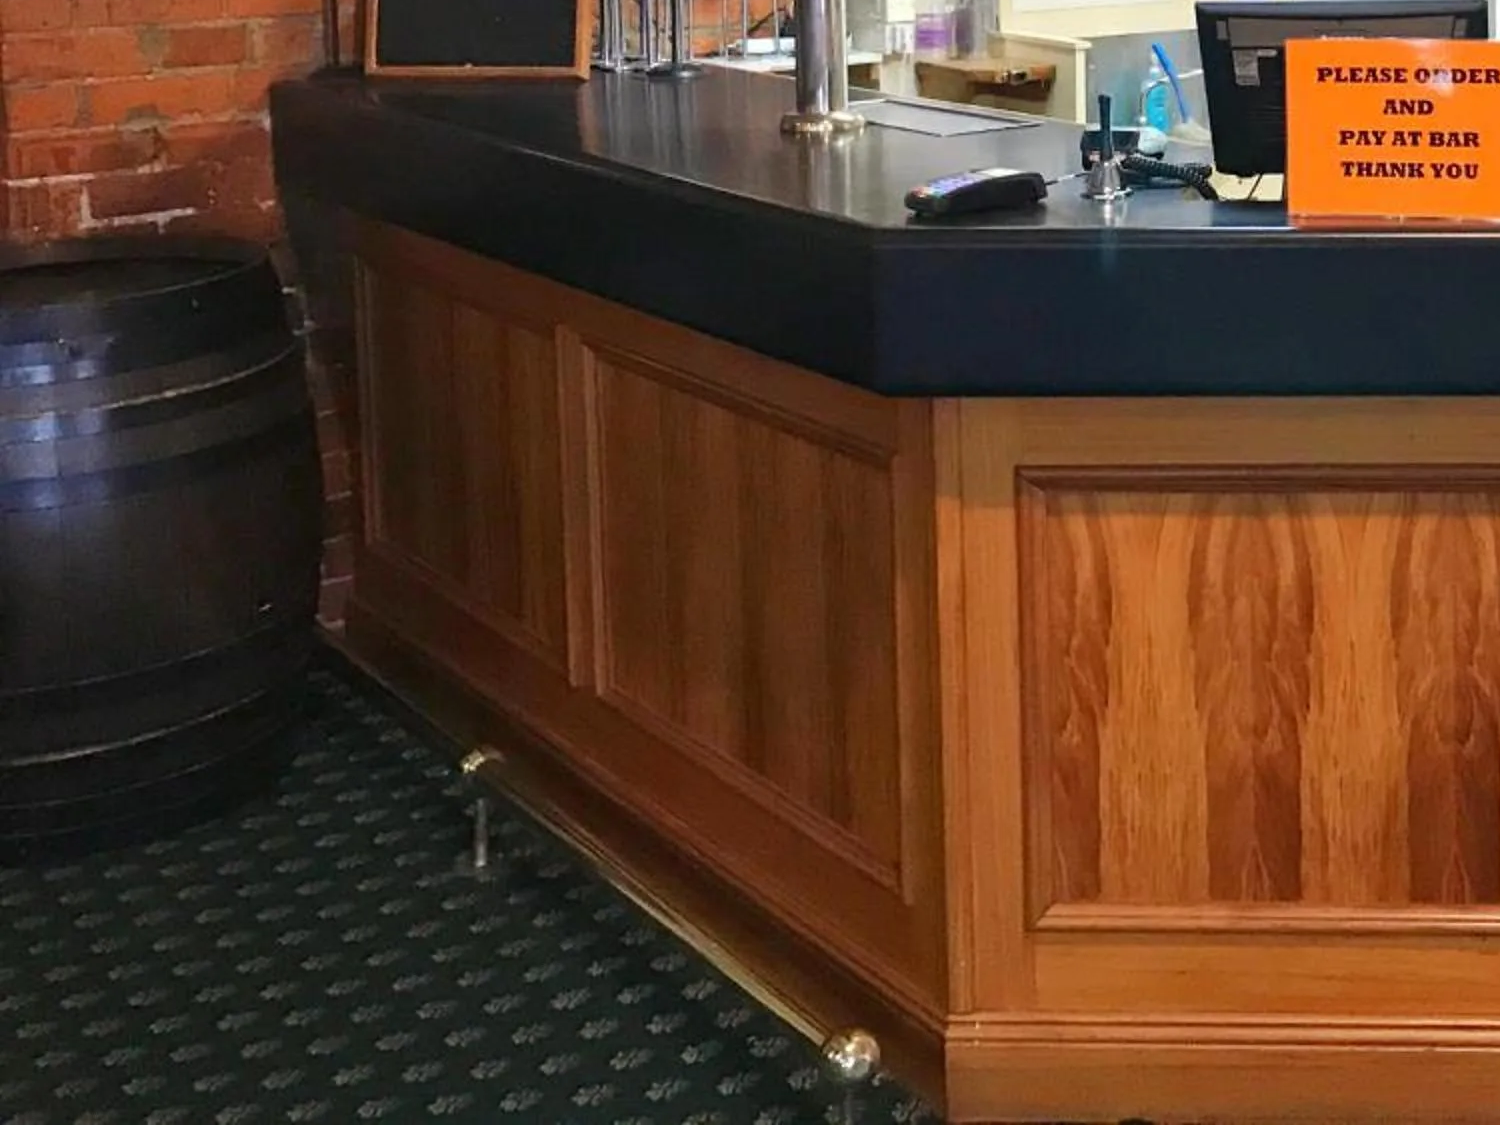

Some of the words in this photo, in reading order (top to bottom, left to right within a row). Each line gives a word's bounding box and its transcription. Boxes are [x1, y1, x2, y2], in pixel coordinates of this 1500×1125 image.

[1316, 66, 1408, 84] PLEASE
[1383, 98, 1434, 116] AND
[1338, 130, 1387, 146] PAY
[1391, 130, 1423, 147] AT
[1428, 131, 1480, 148] BAR
[1340, 161, 1425, 179] THANK
[1430, 162, 1479, 180] YOU
